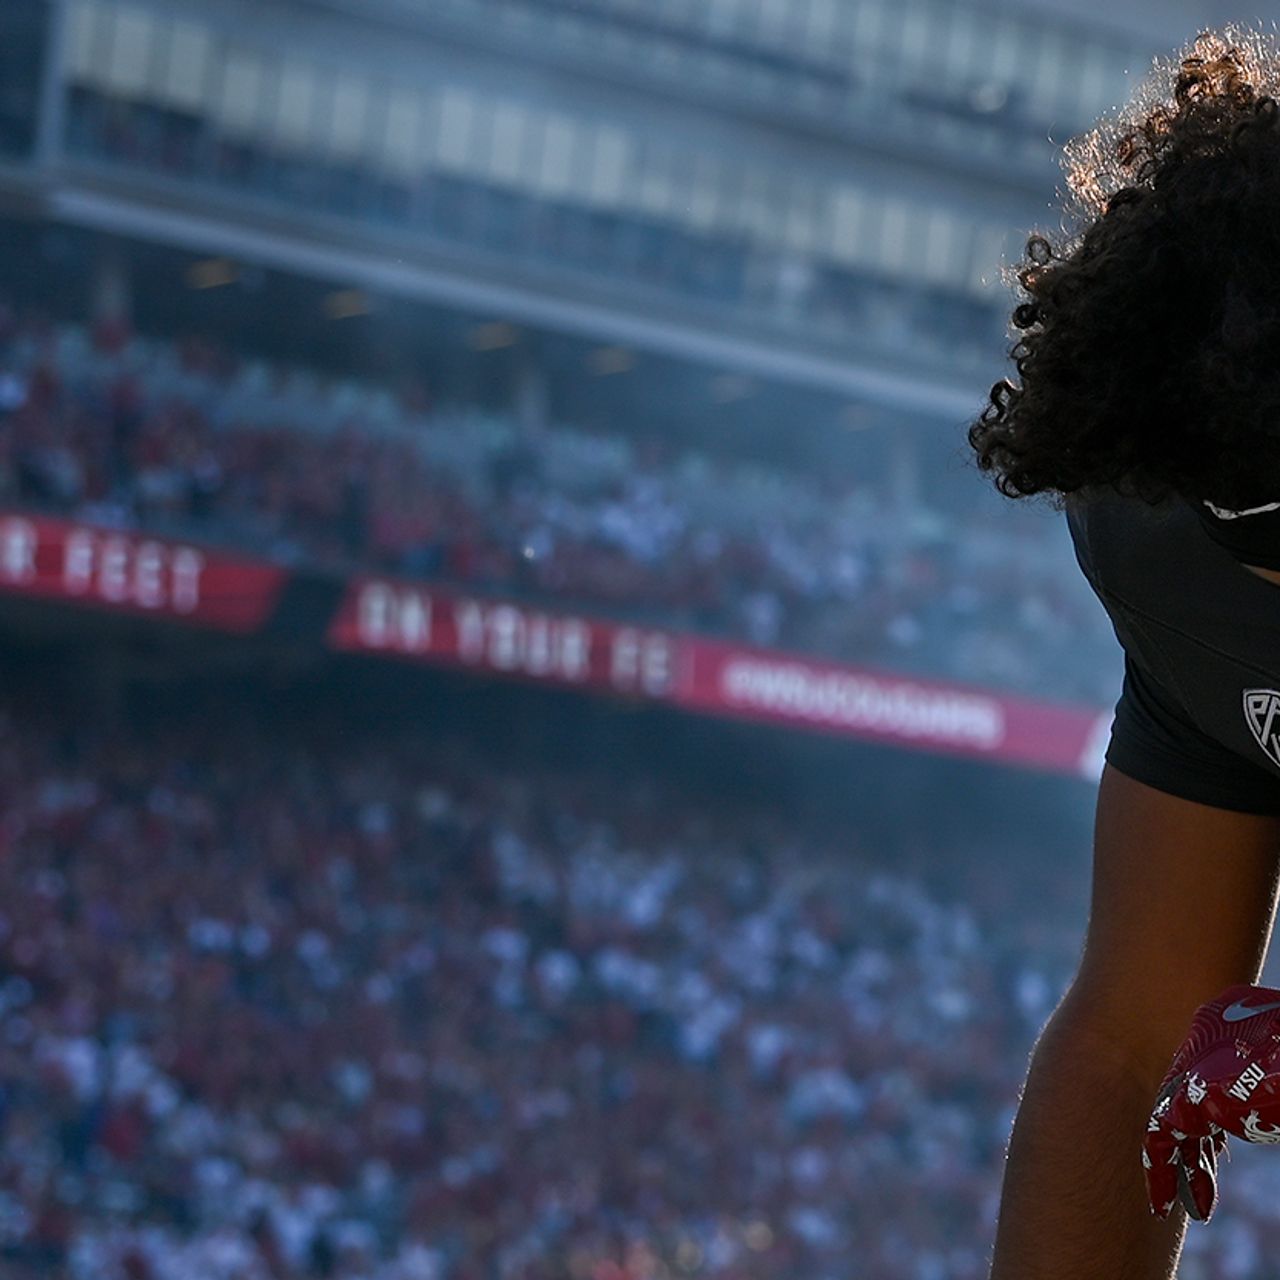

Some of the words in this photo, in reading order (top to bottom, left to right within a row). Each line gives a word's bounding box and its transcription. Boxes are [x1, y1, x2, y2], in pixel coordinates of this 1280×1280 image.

[64, 528, 202, 614] FEET
[457, 597, 589, 681] YOUR
[1228, 1062, 1266, 1102] WSU
